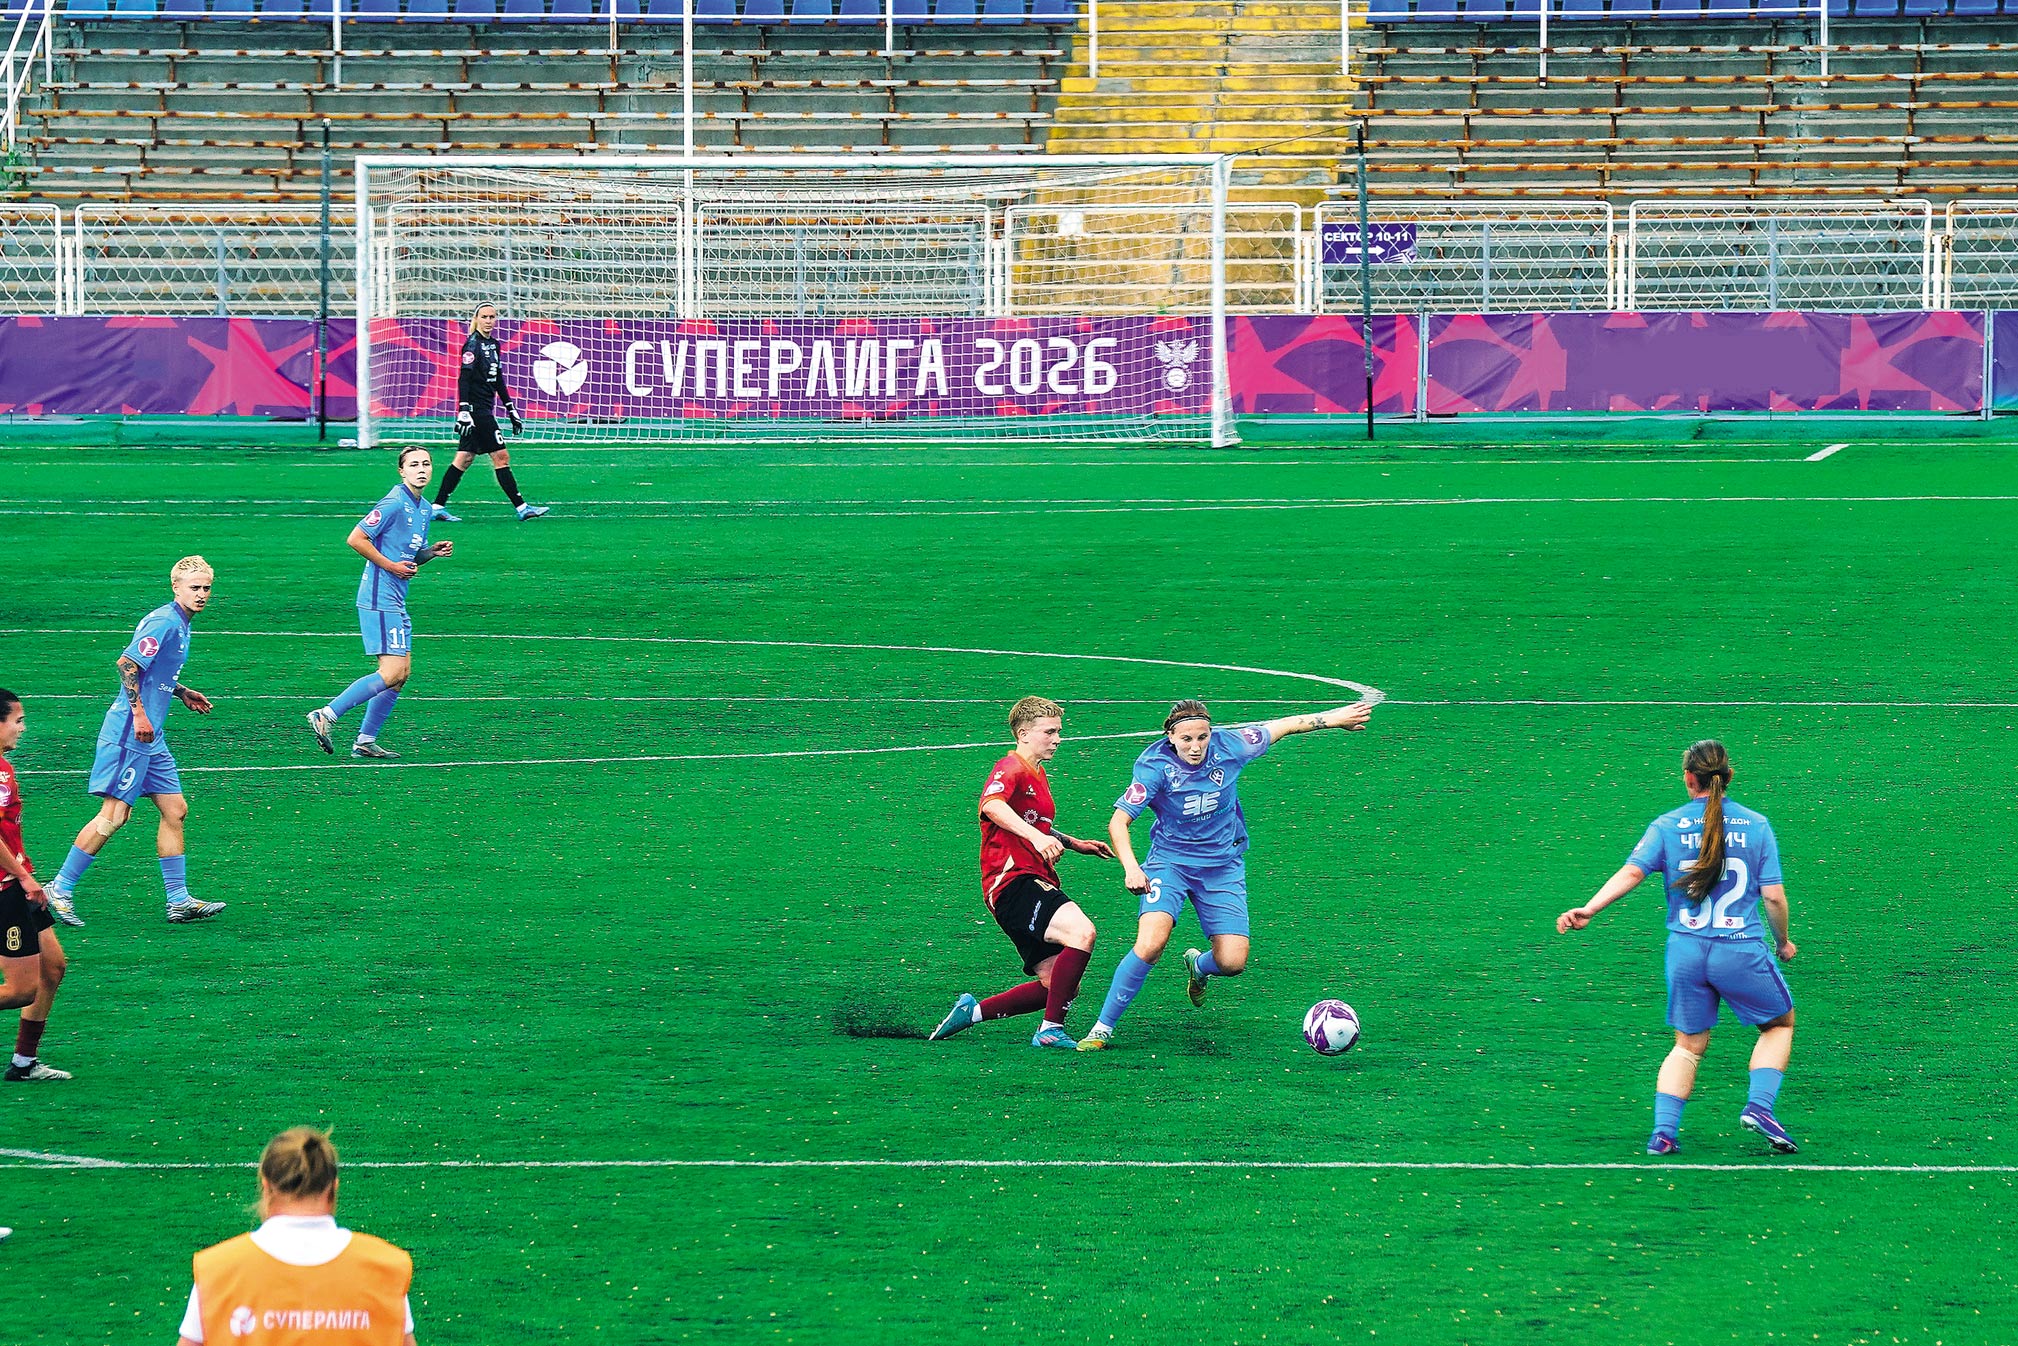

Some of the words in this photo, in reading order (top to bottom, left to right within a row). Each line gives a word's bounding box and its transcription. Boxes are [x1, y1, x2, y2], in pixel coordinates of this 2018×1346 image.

[1375, 232, 1408, 242] 10-11
[624, 338, 949, 398] СУПЕРЛИГА
[974, 337, 1118, 395] 2026
[389, 627, 406, 649] 11
[117, 767, 136, 791] 9
[1729, 817, 1750, 826] ДОН
[6, 926, 22, 951] 8
[262, 1309, 371, 1330] СУПЕРЛИГА
